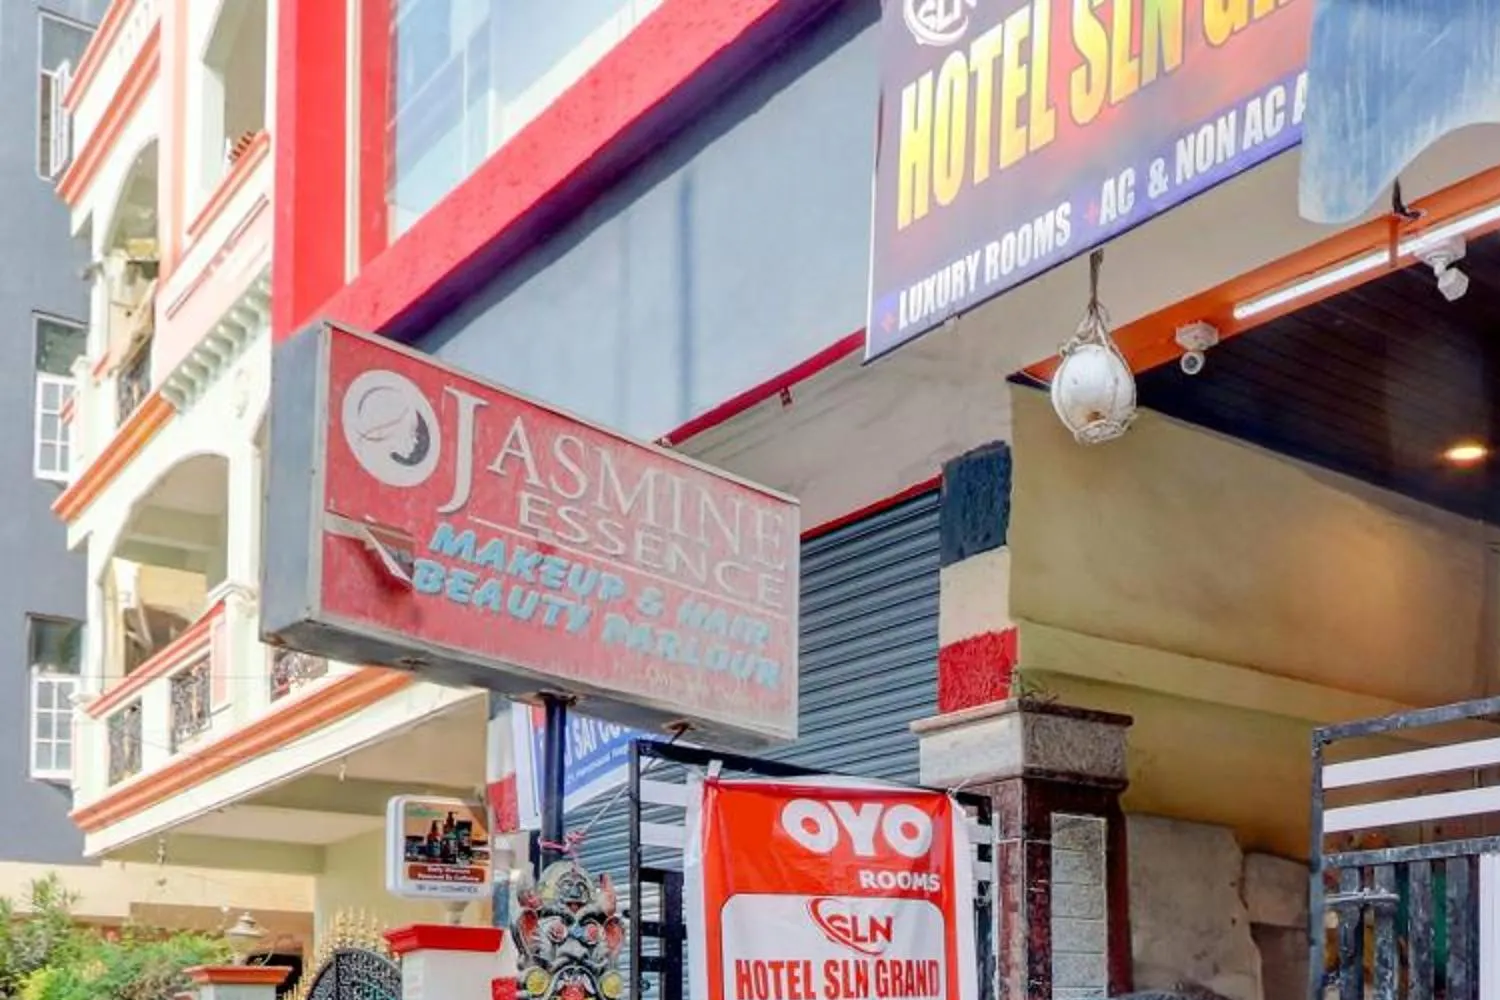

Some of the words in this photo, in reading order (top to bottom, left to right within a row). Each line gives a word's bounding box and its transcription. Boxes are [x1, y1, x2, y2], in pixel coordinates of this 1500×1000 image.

[897, 0, 1056, 231] HOTEL
[1069, 0, 1184, 126] SLN
[898, 250, 981, 331] LUXURY
[984, 201, 1072, 284] ROOMS
[1099, 167, 1136, 221] AC
[1147, 157, 1169, 199] &
[1175, 110, 1237, 185] NON
[1243, 85, 1286, 150] AC
[437, 384, 785, 570] JASMINE
[428, 522, 626, 600] MAKEUP
[637, 586, 665, 617] &
[677, 599, 771, 646] HAIR
[518, 490, 785, 608] ESSENCE
[412, 558, 592, 633] BEAUTY
[602, 613, 782, 690] PARLOUR
[781, 798, 933, 858] OYO
[859, 869, 941, 891] ROOMS
[823, 959, 869, 1000] SLN
[875, 958, 941, 999] GRAND
[827, 914, 894, 943] SLN
